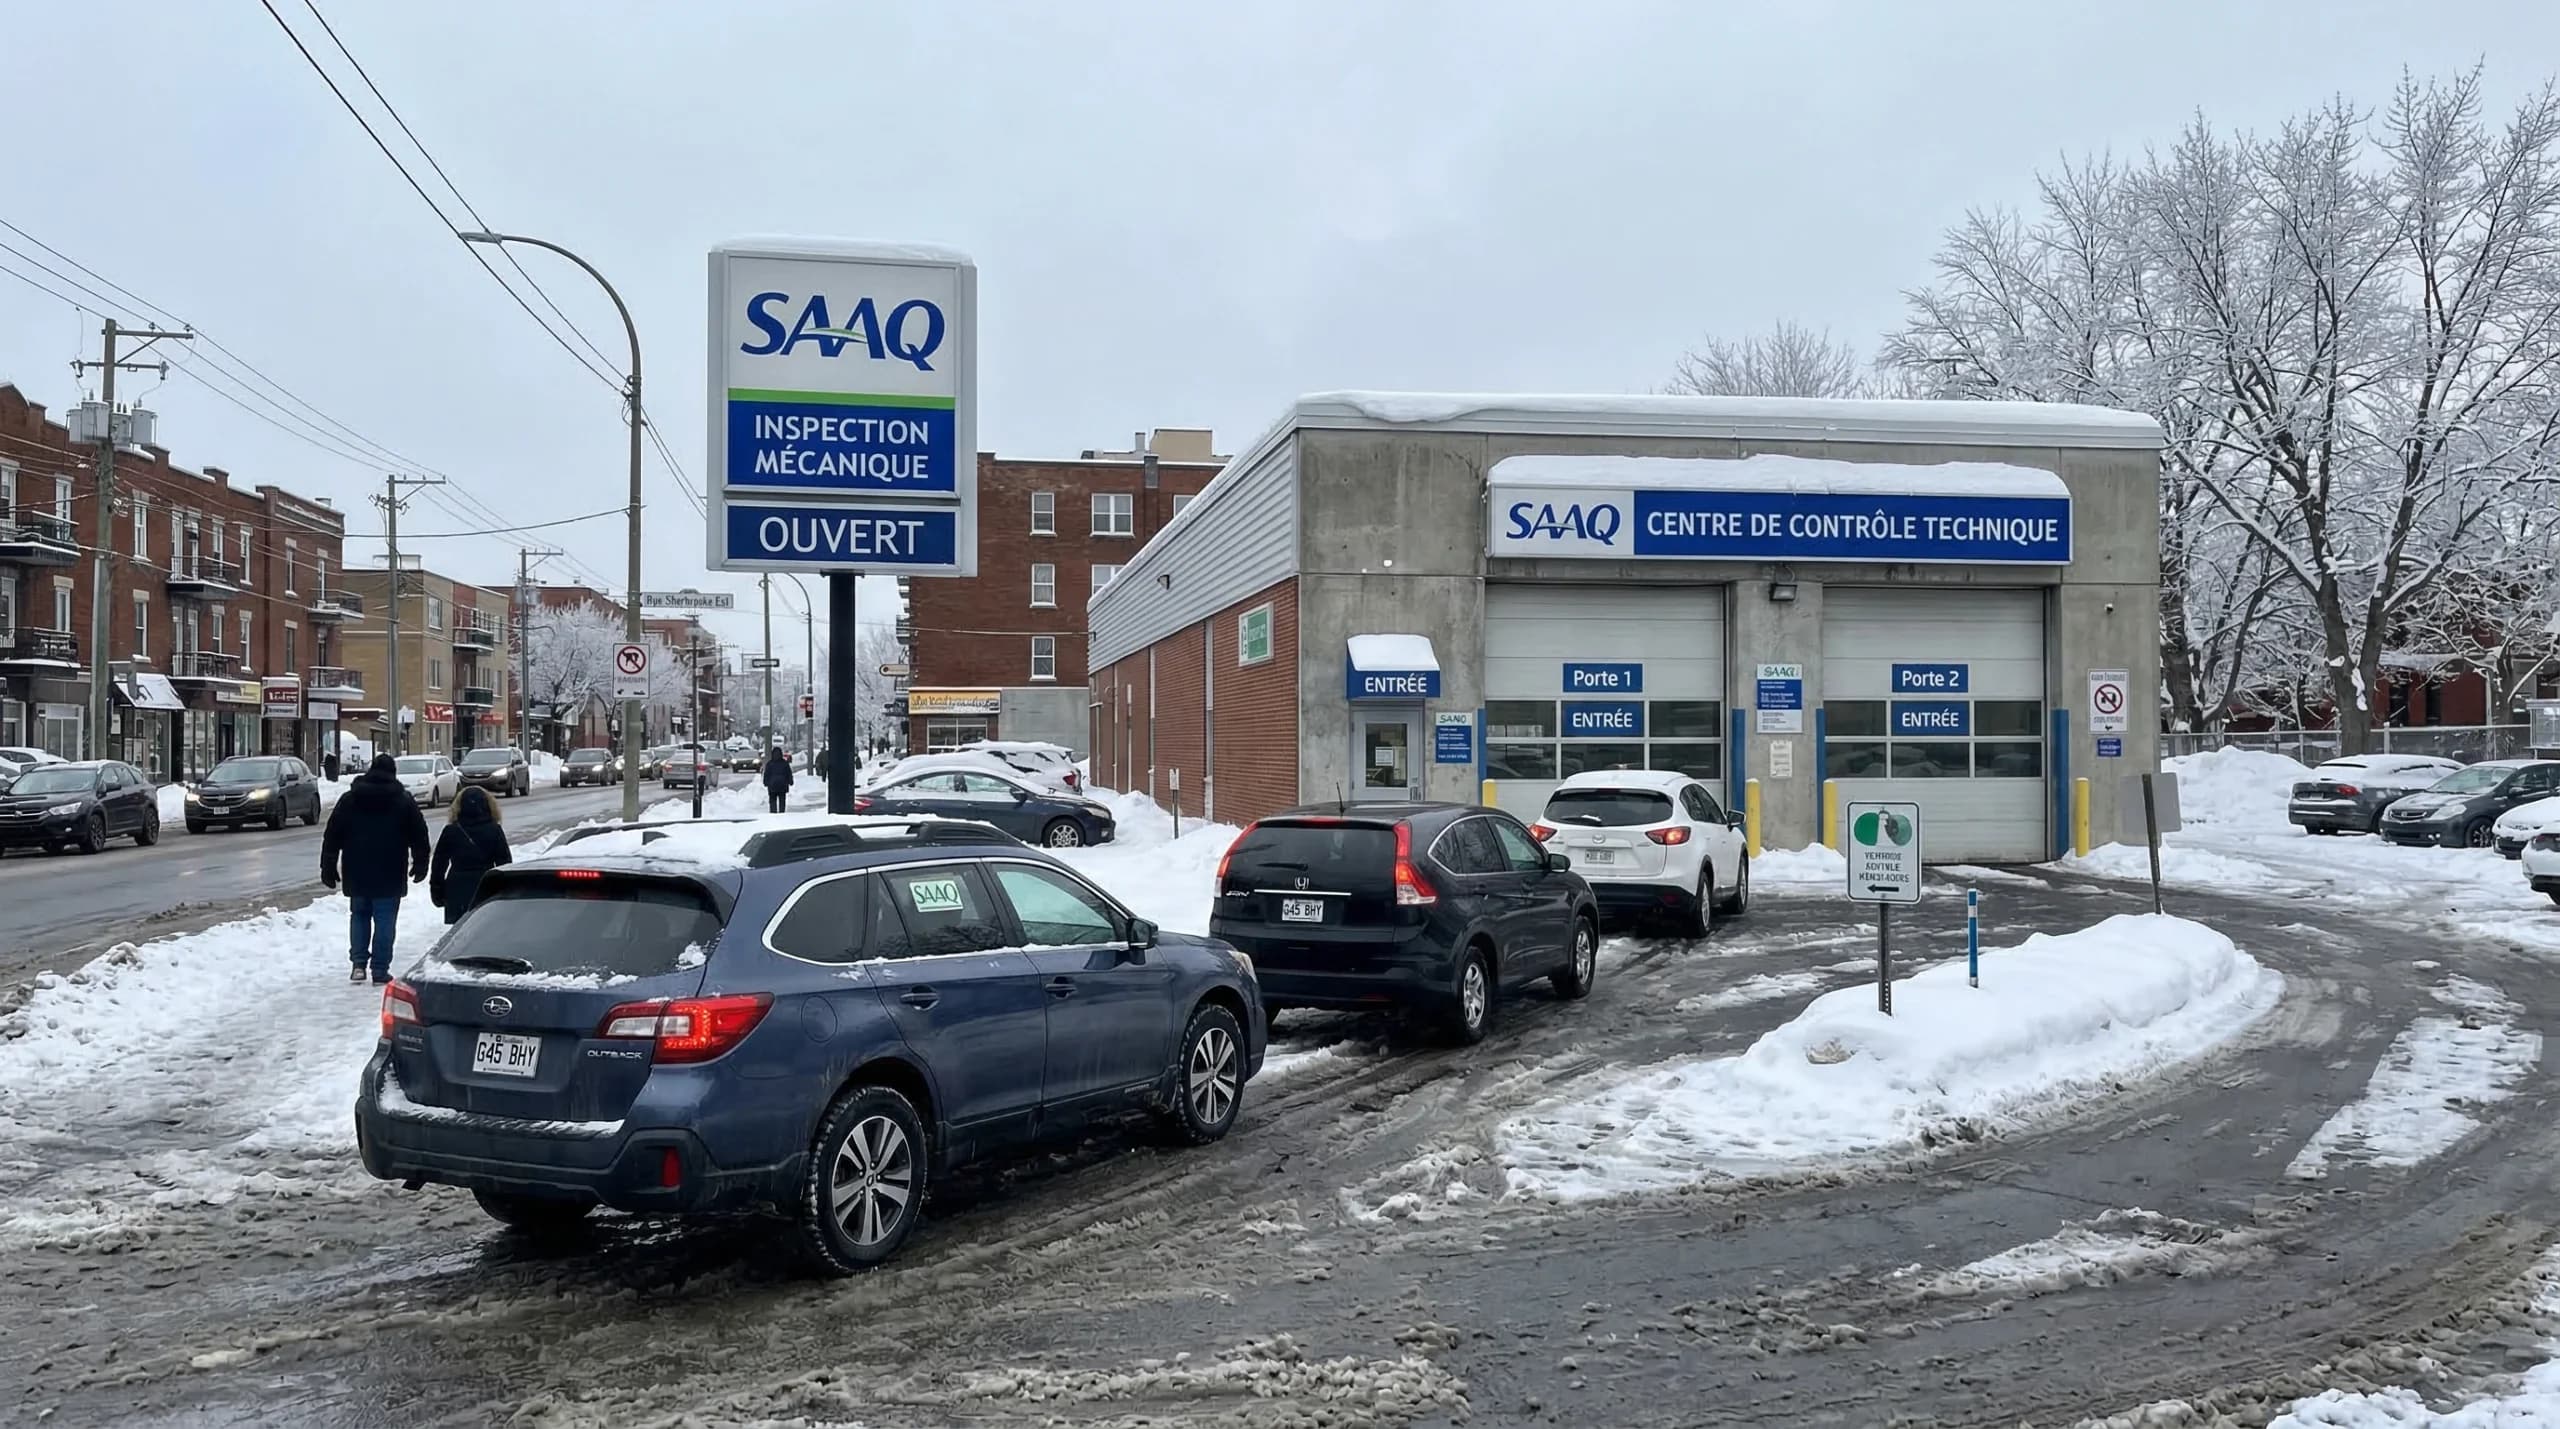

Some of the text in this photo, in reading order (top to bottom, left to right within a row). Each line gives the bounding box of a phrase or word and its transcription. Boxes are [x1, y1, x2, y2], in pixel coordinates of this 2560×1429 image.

[740, 292, 946, 371] SAAQ
[754, 414, 929, 446] INSPECTION
[754, 443, 929, 482] MÉCANIQUE
[759, 516, 925, 556] OUVERT
[1505, 502, 1621, 546] SAAQ
[1647, 508, 2059, 546] CENTRE DE CONTRÔLE TECHNIQUE
[1573, 669, 1631, 687] Porte 1
[1902, 670, 1960, 687] Porte 2
[1572, 708, 1633, 728] ENTRÉE
[1902, 708, 1960, 728] ENTRÉE
[913, 883, 959, 904] SAAQ
[476, 1041, 537, 1068] G45 BHY
